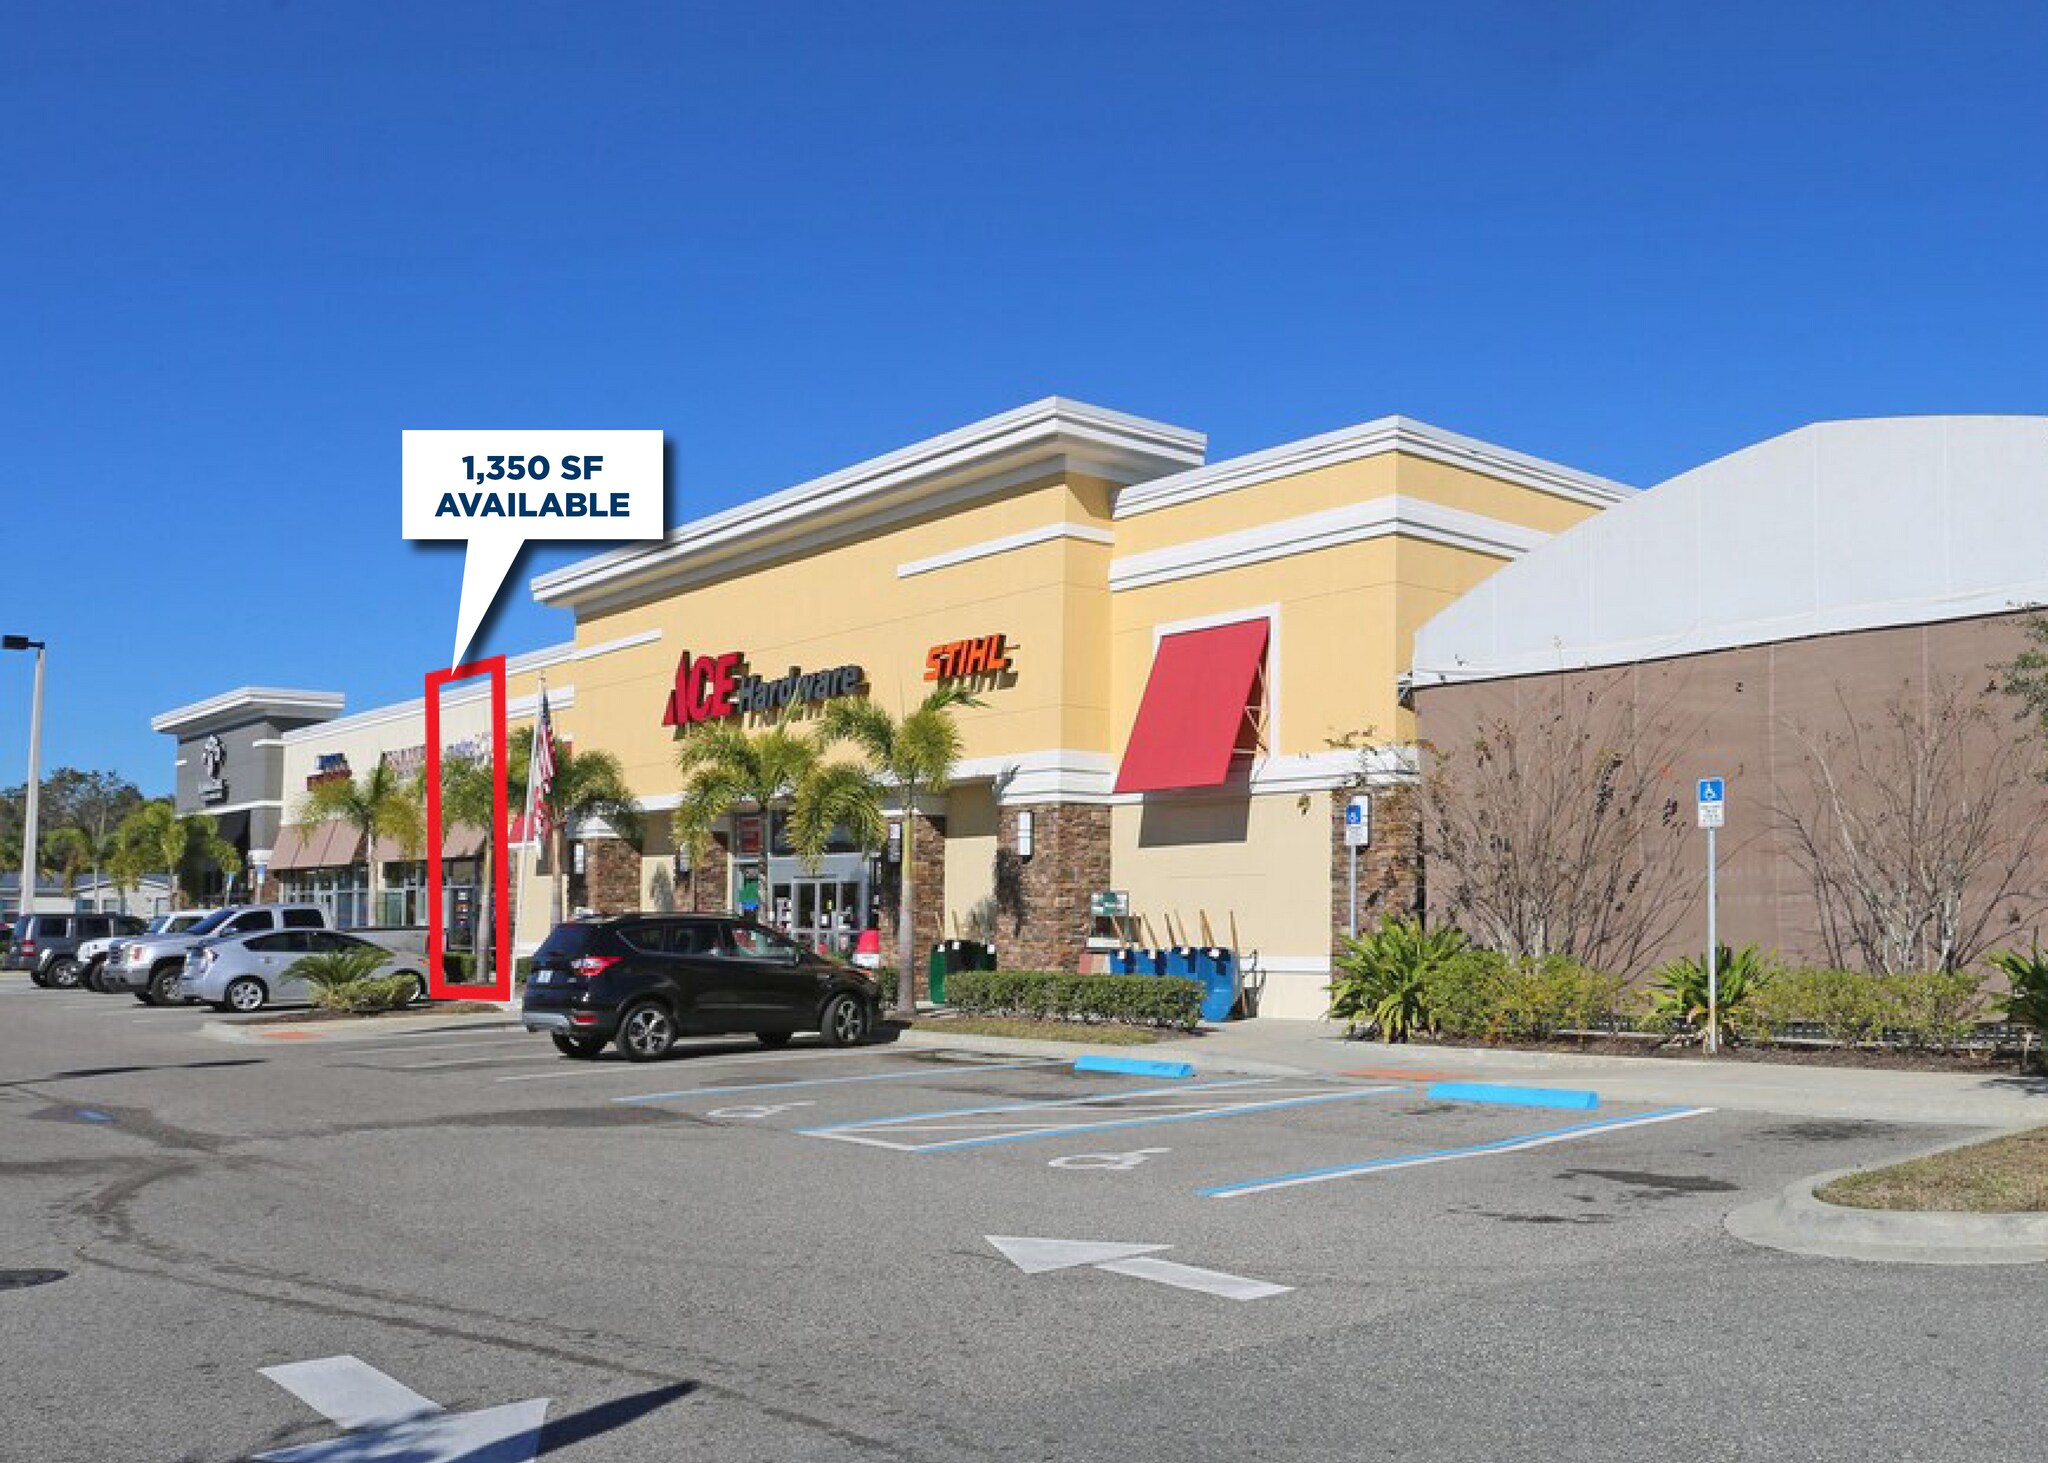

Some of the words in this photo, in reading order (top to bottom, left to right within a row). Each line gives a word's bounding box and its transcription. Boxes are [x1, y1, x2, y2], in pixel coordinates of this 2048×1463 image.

[664, 651, 741, 726] ACE
[739, 665, 862, 712] Hardware
[923, 634, 1007, 682] STIHL
